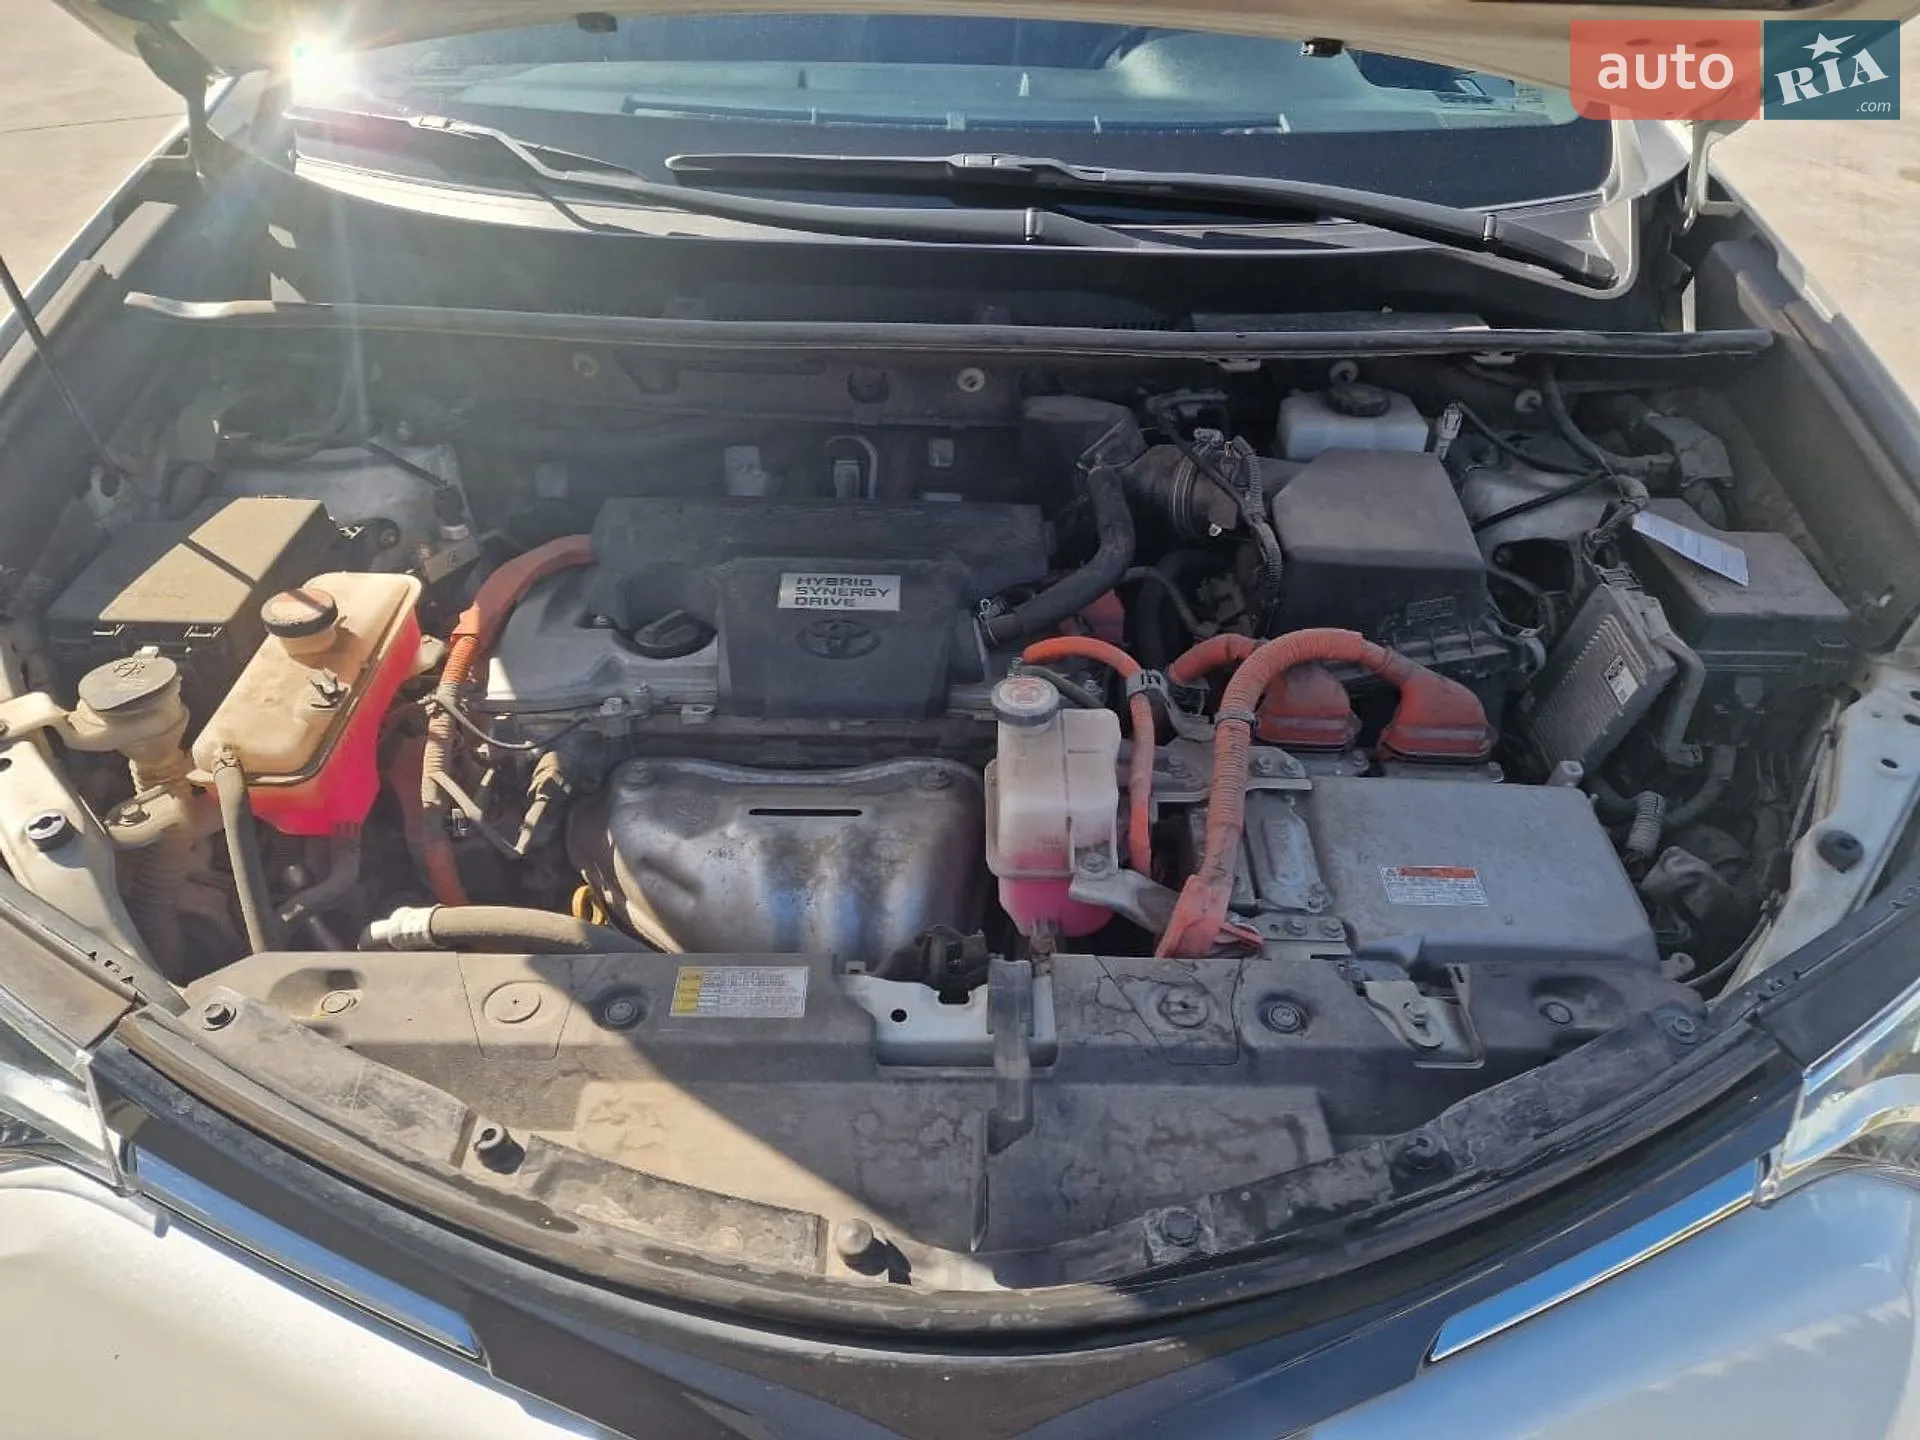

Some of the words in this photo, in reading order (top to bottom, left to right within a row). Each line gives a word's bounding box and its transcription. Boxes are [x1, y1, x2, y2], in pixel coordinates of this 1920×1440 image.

[797, 577, 873, 587] HYBRID
[796, 586, 890, 598] SYNERGY
[794, 597, 856, 607] DRIVE
